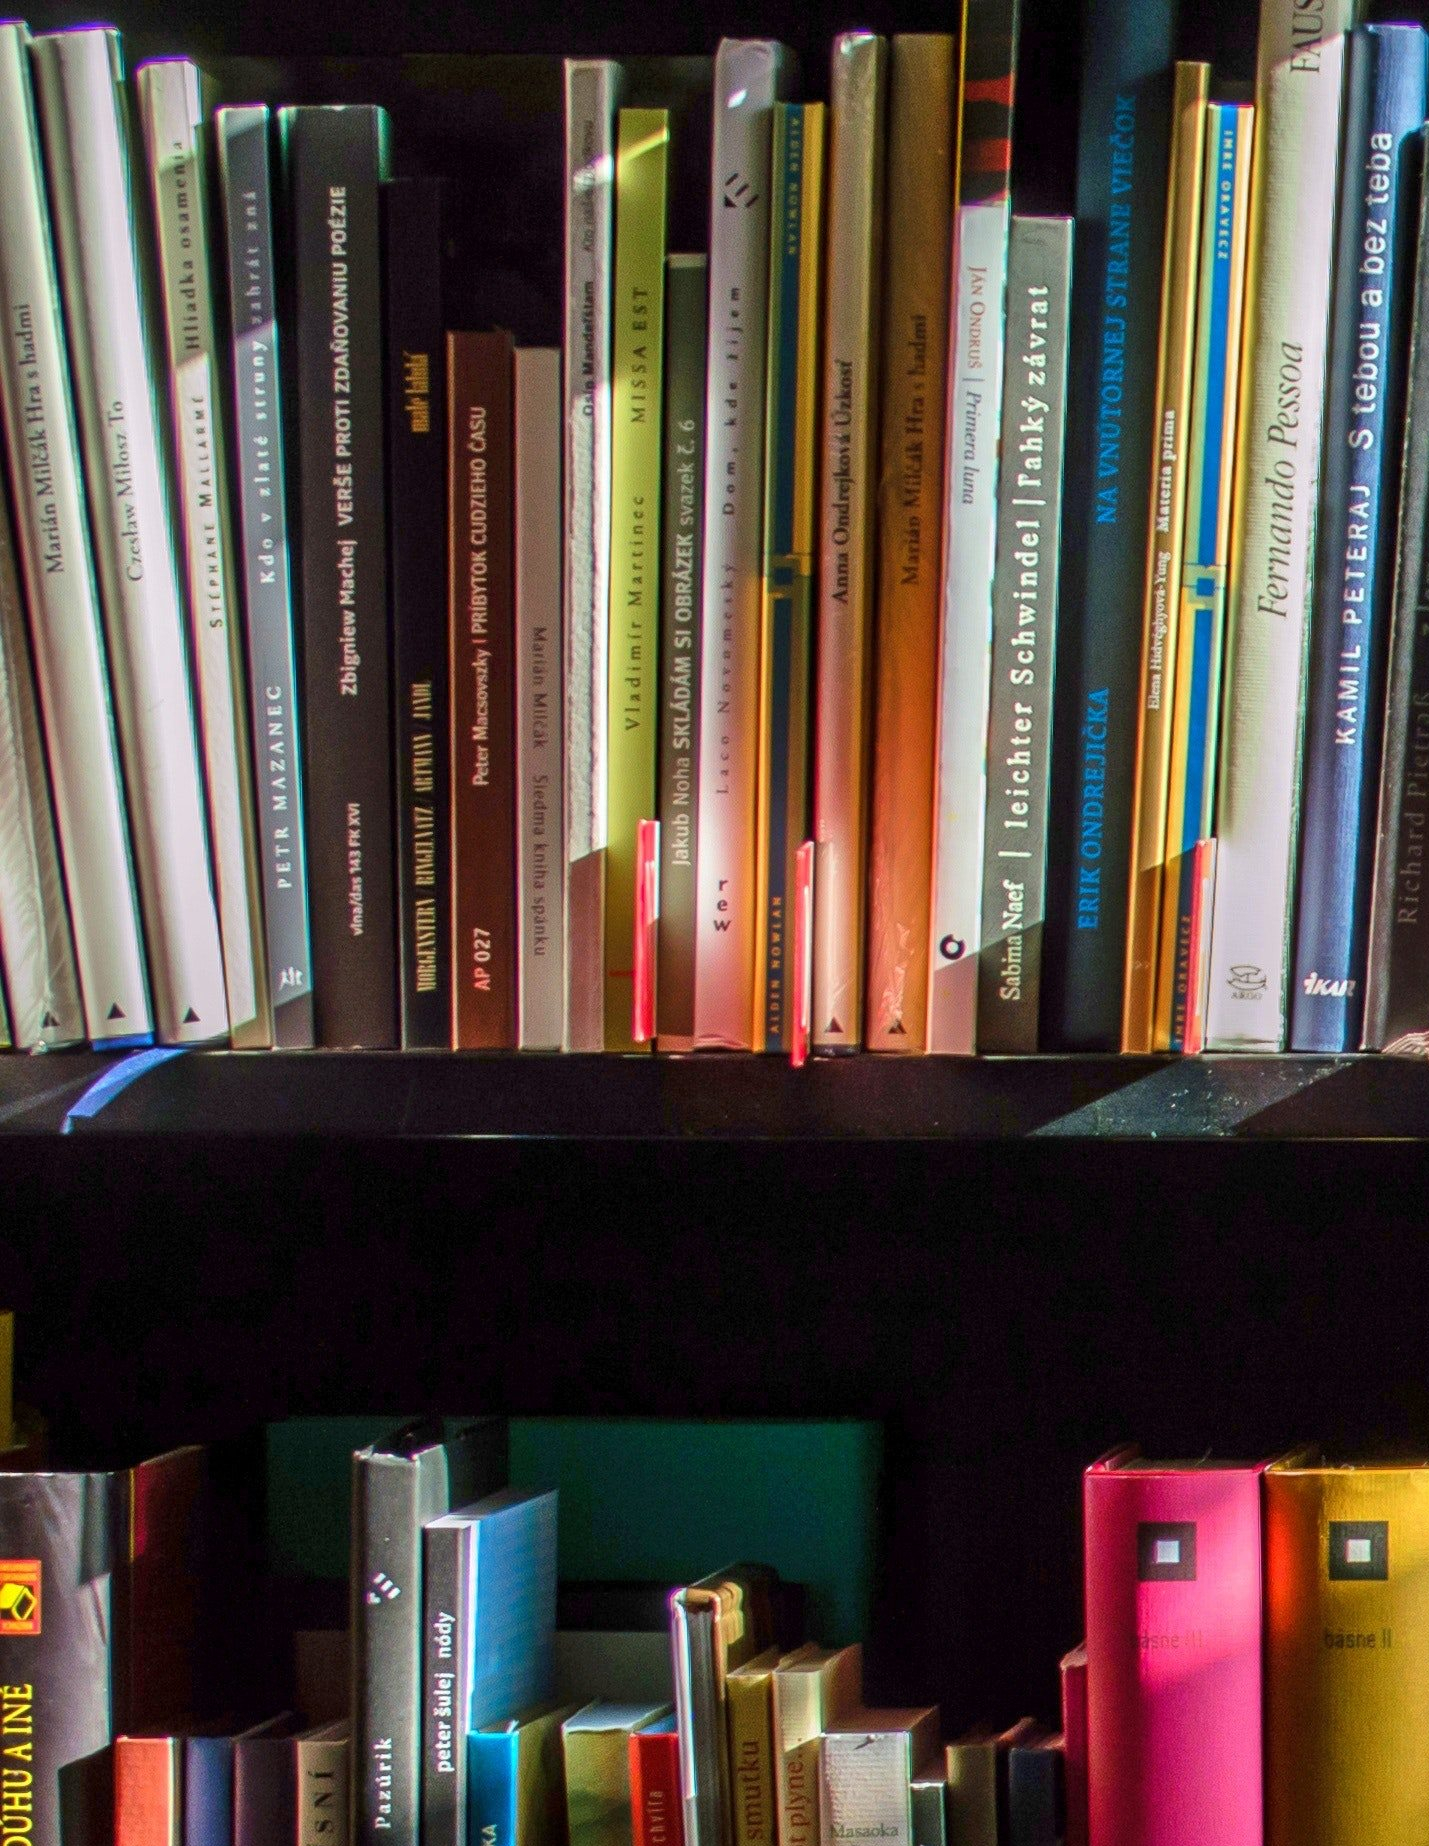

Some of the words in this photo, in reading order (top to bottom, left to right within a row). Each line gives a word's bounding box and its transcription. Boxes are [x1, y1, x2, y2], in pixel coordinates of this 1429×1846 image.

[1366, 131, 1393, 205] teba
[1358, 217, 1388, 275] bez
[180, 258, 201, 351] Hliadka
[631, 284, 649, 331] EST
[249, 338, 271, 420] struny
[630, 344, 648, 424] MISSA
[1267, 341, 1304, 448] Pessoa
[1353, 320, 1382, 414] tebou
[333, 399, 351, 456] PROTI
[330, 460, 353, 525] VERŠE
[40, 503, 65, 574] Marián
[256, 536, 277, 584] Kdo
[627, 494, 645, 607] Martinec
[1256, 459, 1296, 619] Fernando
[1341, 483, 1371, 625] PETERAJ
[337, 540, 359, 605] Machej
[831, 552, 850, 605] Anna
[1008, 518, 1041, 685] Schwindel
[340, 608, 362, 695] Zbigniew
[625, 620, 644, 732] Vladimír
[1335, 643, 1363, 746] KAMIL
[265, 683, 288, 811] MAZANEC
[471, 745, 490, 787] Peter
[1003, 700, 1034, 829] leichter
[1077, 687, 1109, 861] ONDREJIČKA
[671, 757, 691, 806] Noha
[273, 825, 293, 889] PETR
[671, 813, 692, 866] Jakub
[1000, 881, 1025, 931] Naef
[1077, 868, 1102, 930] ERIK
[472, 927, 490, 963] 027
[1000, 935, 1022, 1001] Sabina
[473, 967, 491, 992] AP
[433, 1611, 457, 1659] nódy
[431, 1673, 456, 1717] šulej
[433, 1721, 455, 1773] peter
[374, 1737, 392, 1829] Pazúrik
